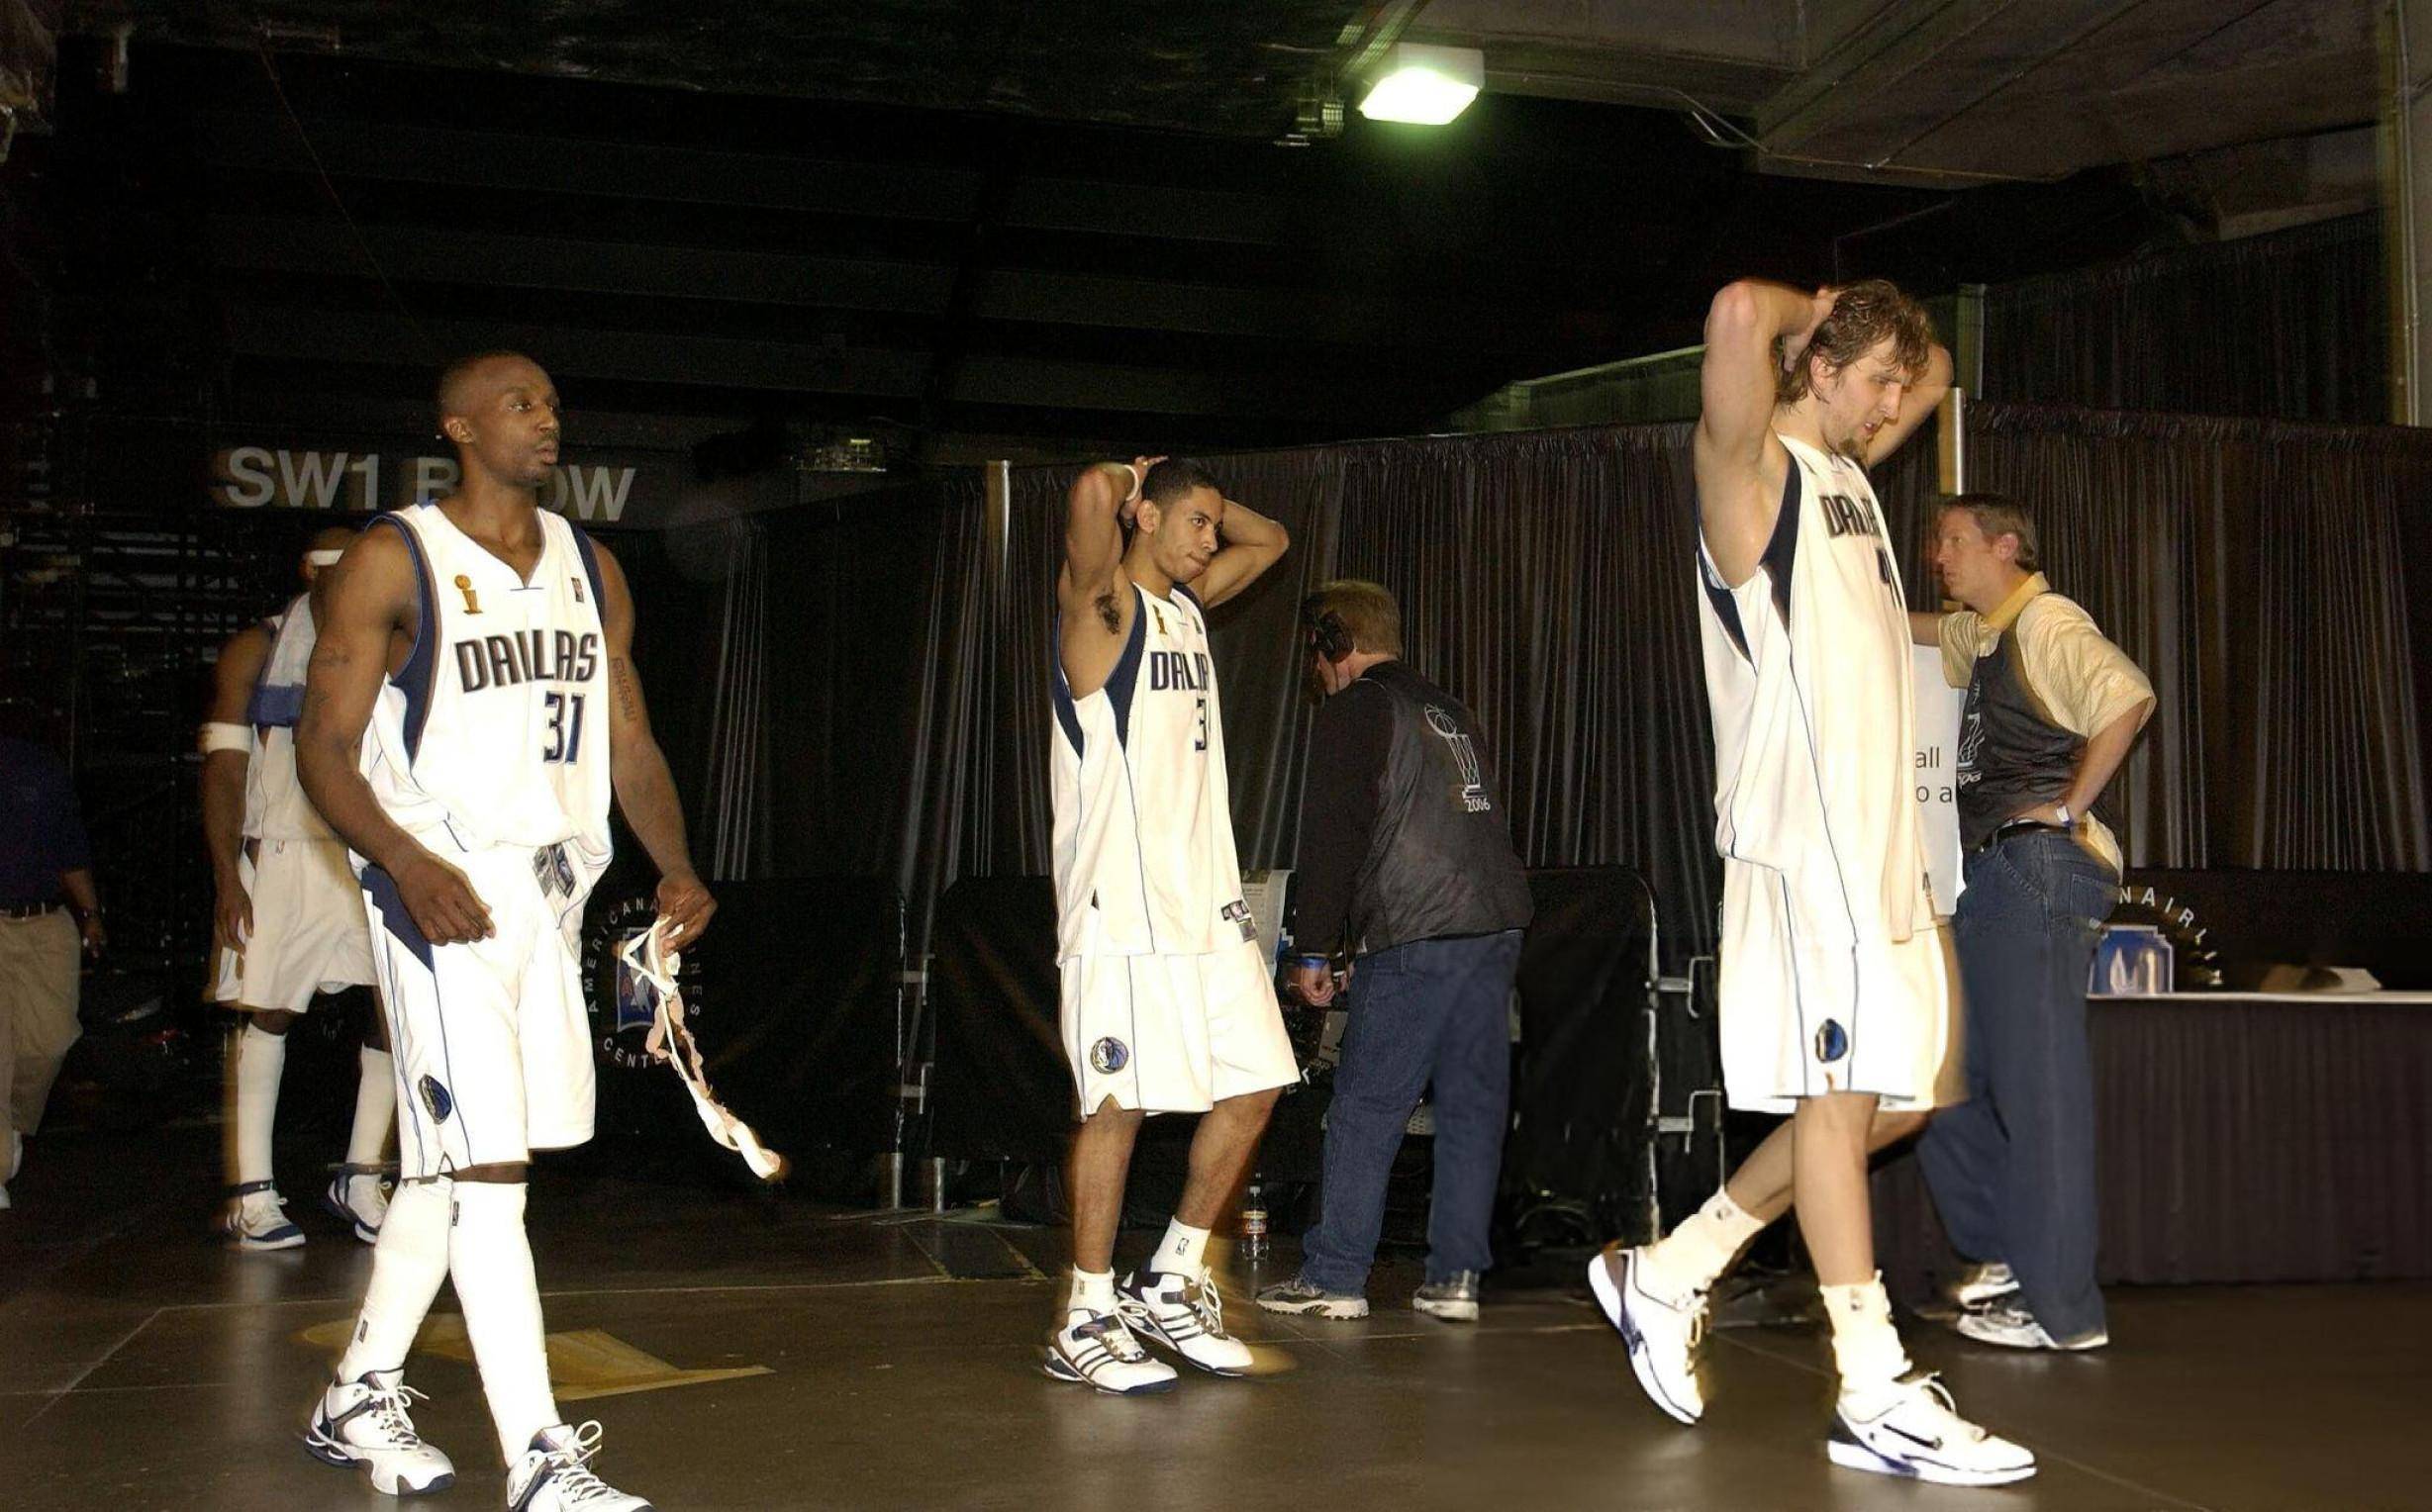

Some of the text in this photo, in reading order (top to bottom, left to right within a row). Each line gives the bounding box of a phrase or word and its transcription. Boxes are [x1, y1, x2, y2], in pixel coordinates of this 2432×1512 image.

[227, 446, 380, 511] SW1
[454, 628, 598, 693] DALLAS
[1150, 650, 1209, 691] DALLA
[543, 690, 585, 765] 31
[1464, 798, 1492, 812] 2006
[603, 1036, 661, 1070] CENT
